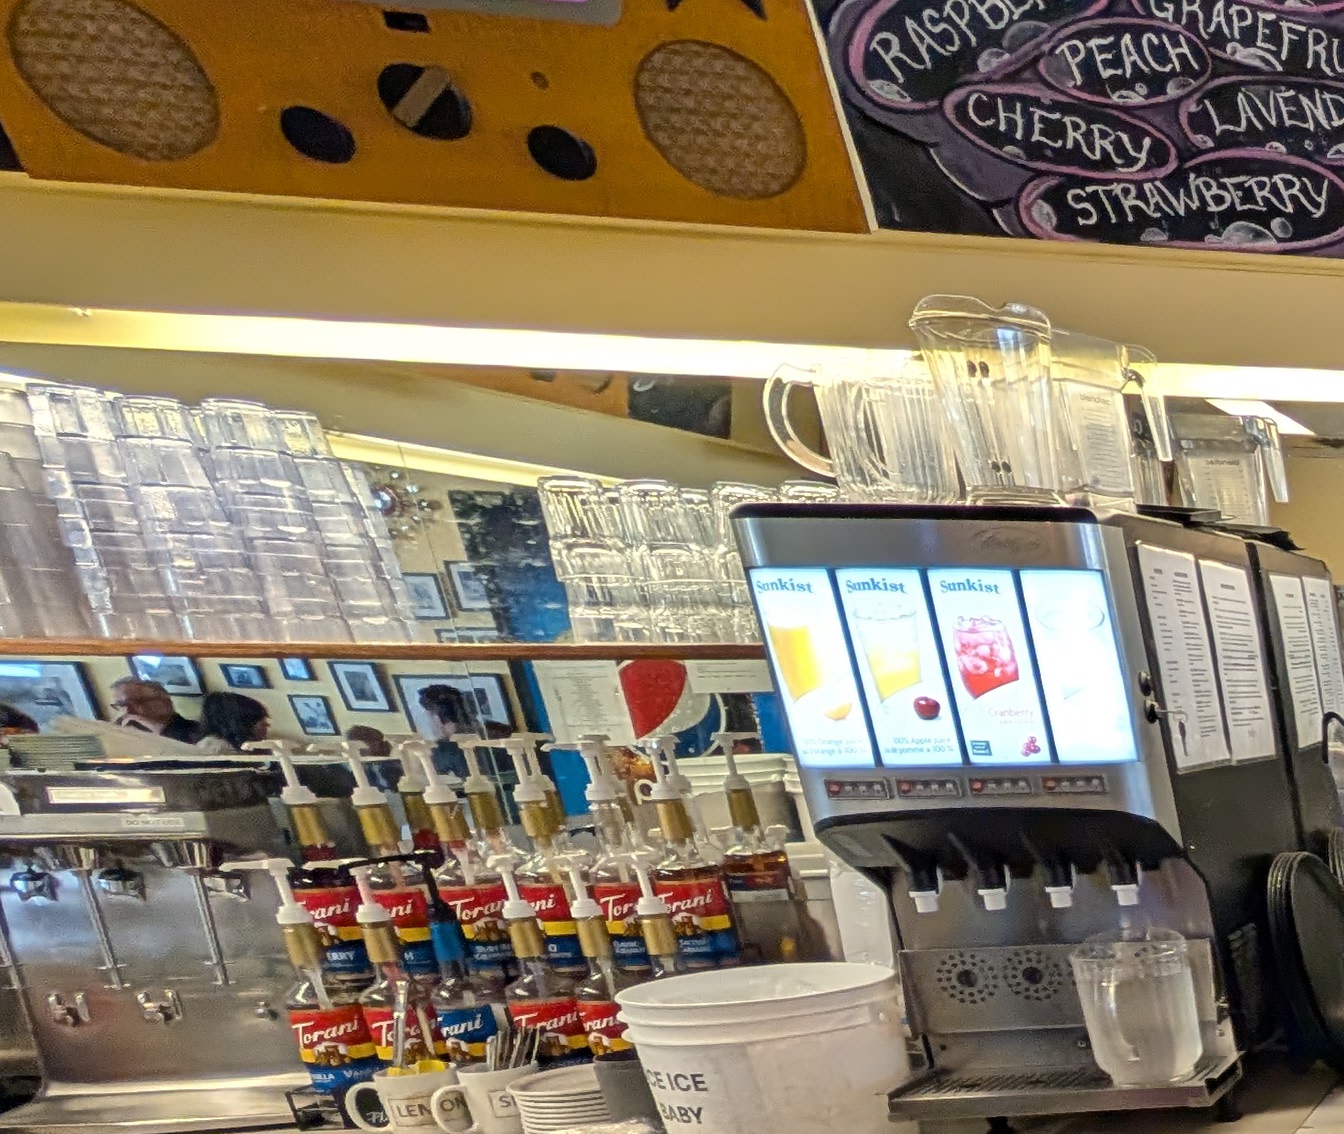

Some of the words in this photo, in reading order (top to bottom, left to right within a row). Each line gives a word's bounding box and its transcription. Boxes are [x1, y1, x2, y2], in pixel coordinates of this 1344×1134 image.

[1055, 33, 1199, 86] PEACH
[968, 92, 1151, 172] CHERRY
[1066, 173, 1330, 226] STRAWBERRY
[755, 577, 816, 595] Sunkist
[845, 577, 907, 595] Sunkist
[939, 577, 1001, 595] Sunkist
[299, 897, 350, 921] rani
[292, 1015, 359, 1052] Torani
[437, 1012, 483, 1038] rani
[512, 1010, 578, 1037] Trani
[647, 1069, 667, 1090] CE
[667, 1072, 708, 1092] ICE
[658, 1102, 703, 1125] BABY
